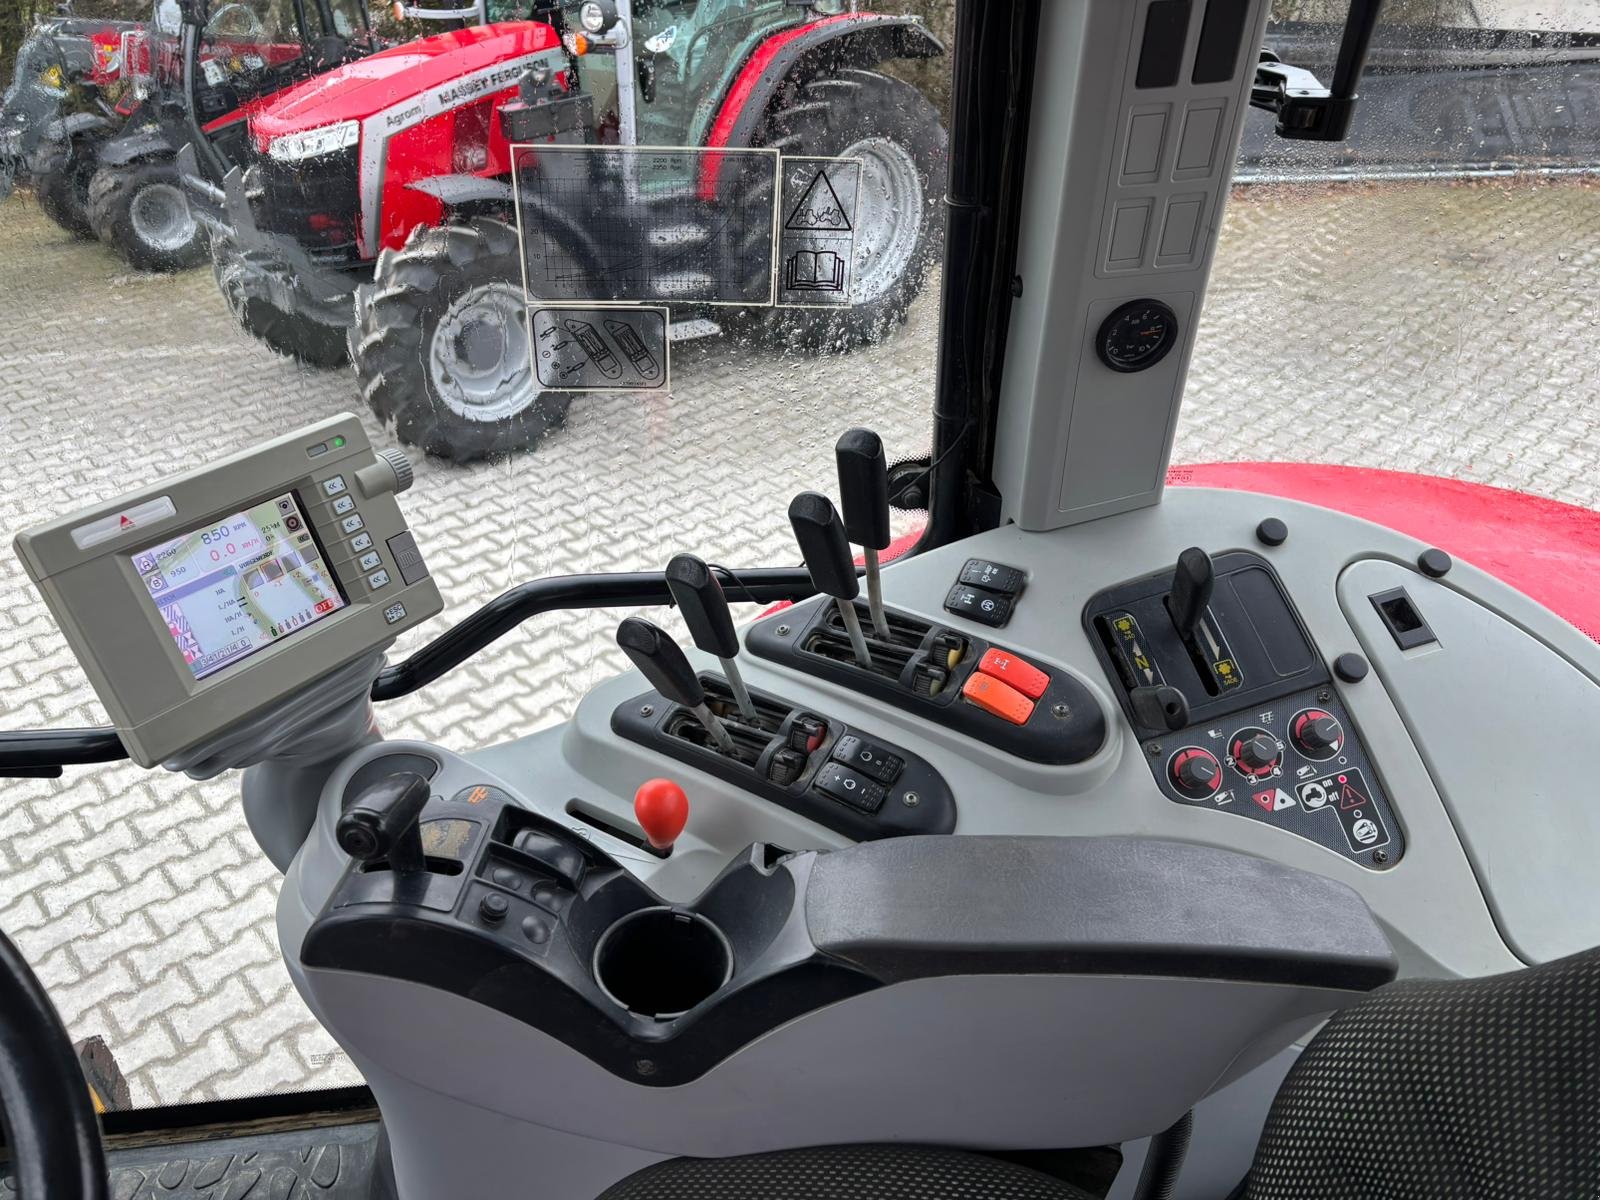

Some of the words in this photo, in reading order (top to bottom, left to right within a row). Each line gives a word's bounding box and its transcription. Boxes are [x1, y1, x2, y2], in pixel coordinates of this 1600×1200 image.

[438, 77, 489, 104] MASSEY
[490, 57, 549, 87] FERGUSON
[201, 525, 230, 545] 850
[210, 542, 236, 561] 0.0
[316, 599, 335, 613] OFF
[389, 604, 402, 615] ESC
[1135, 655, 1150, 670] N
[1276, 741, 1285, 750] 5
[1226, 757, 1235, 766] 2
[1272, 767, 1281, 776] 4
[1248, 775, 1257, 784] 3
[1322, 779, 1333, 788] on
[1328, 791, 1340, 802] off
